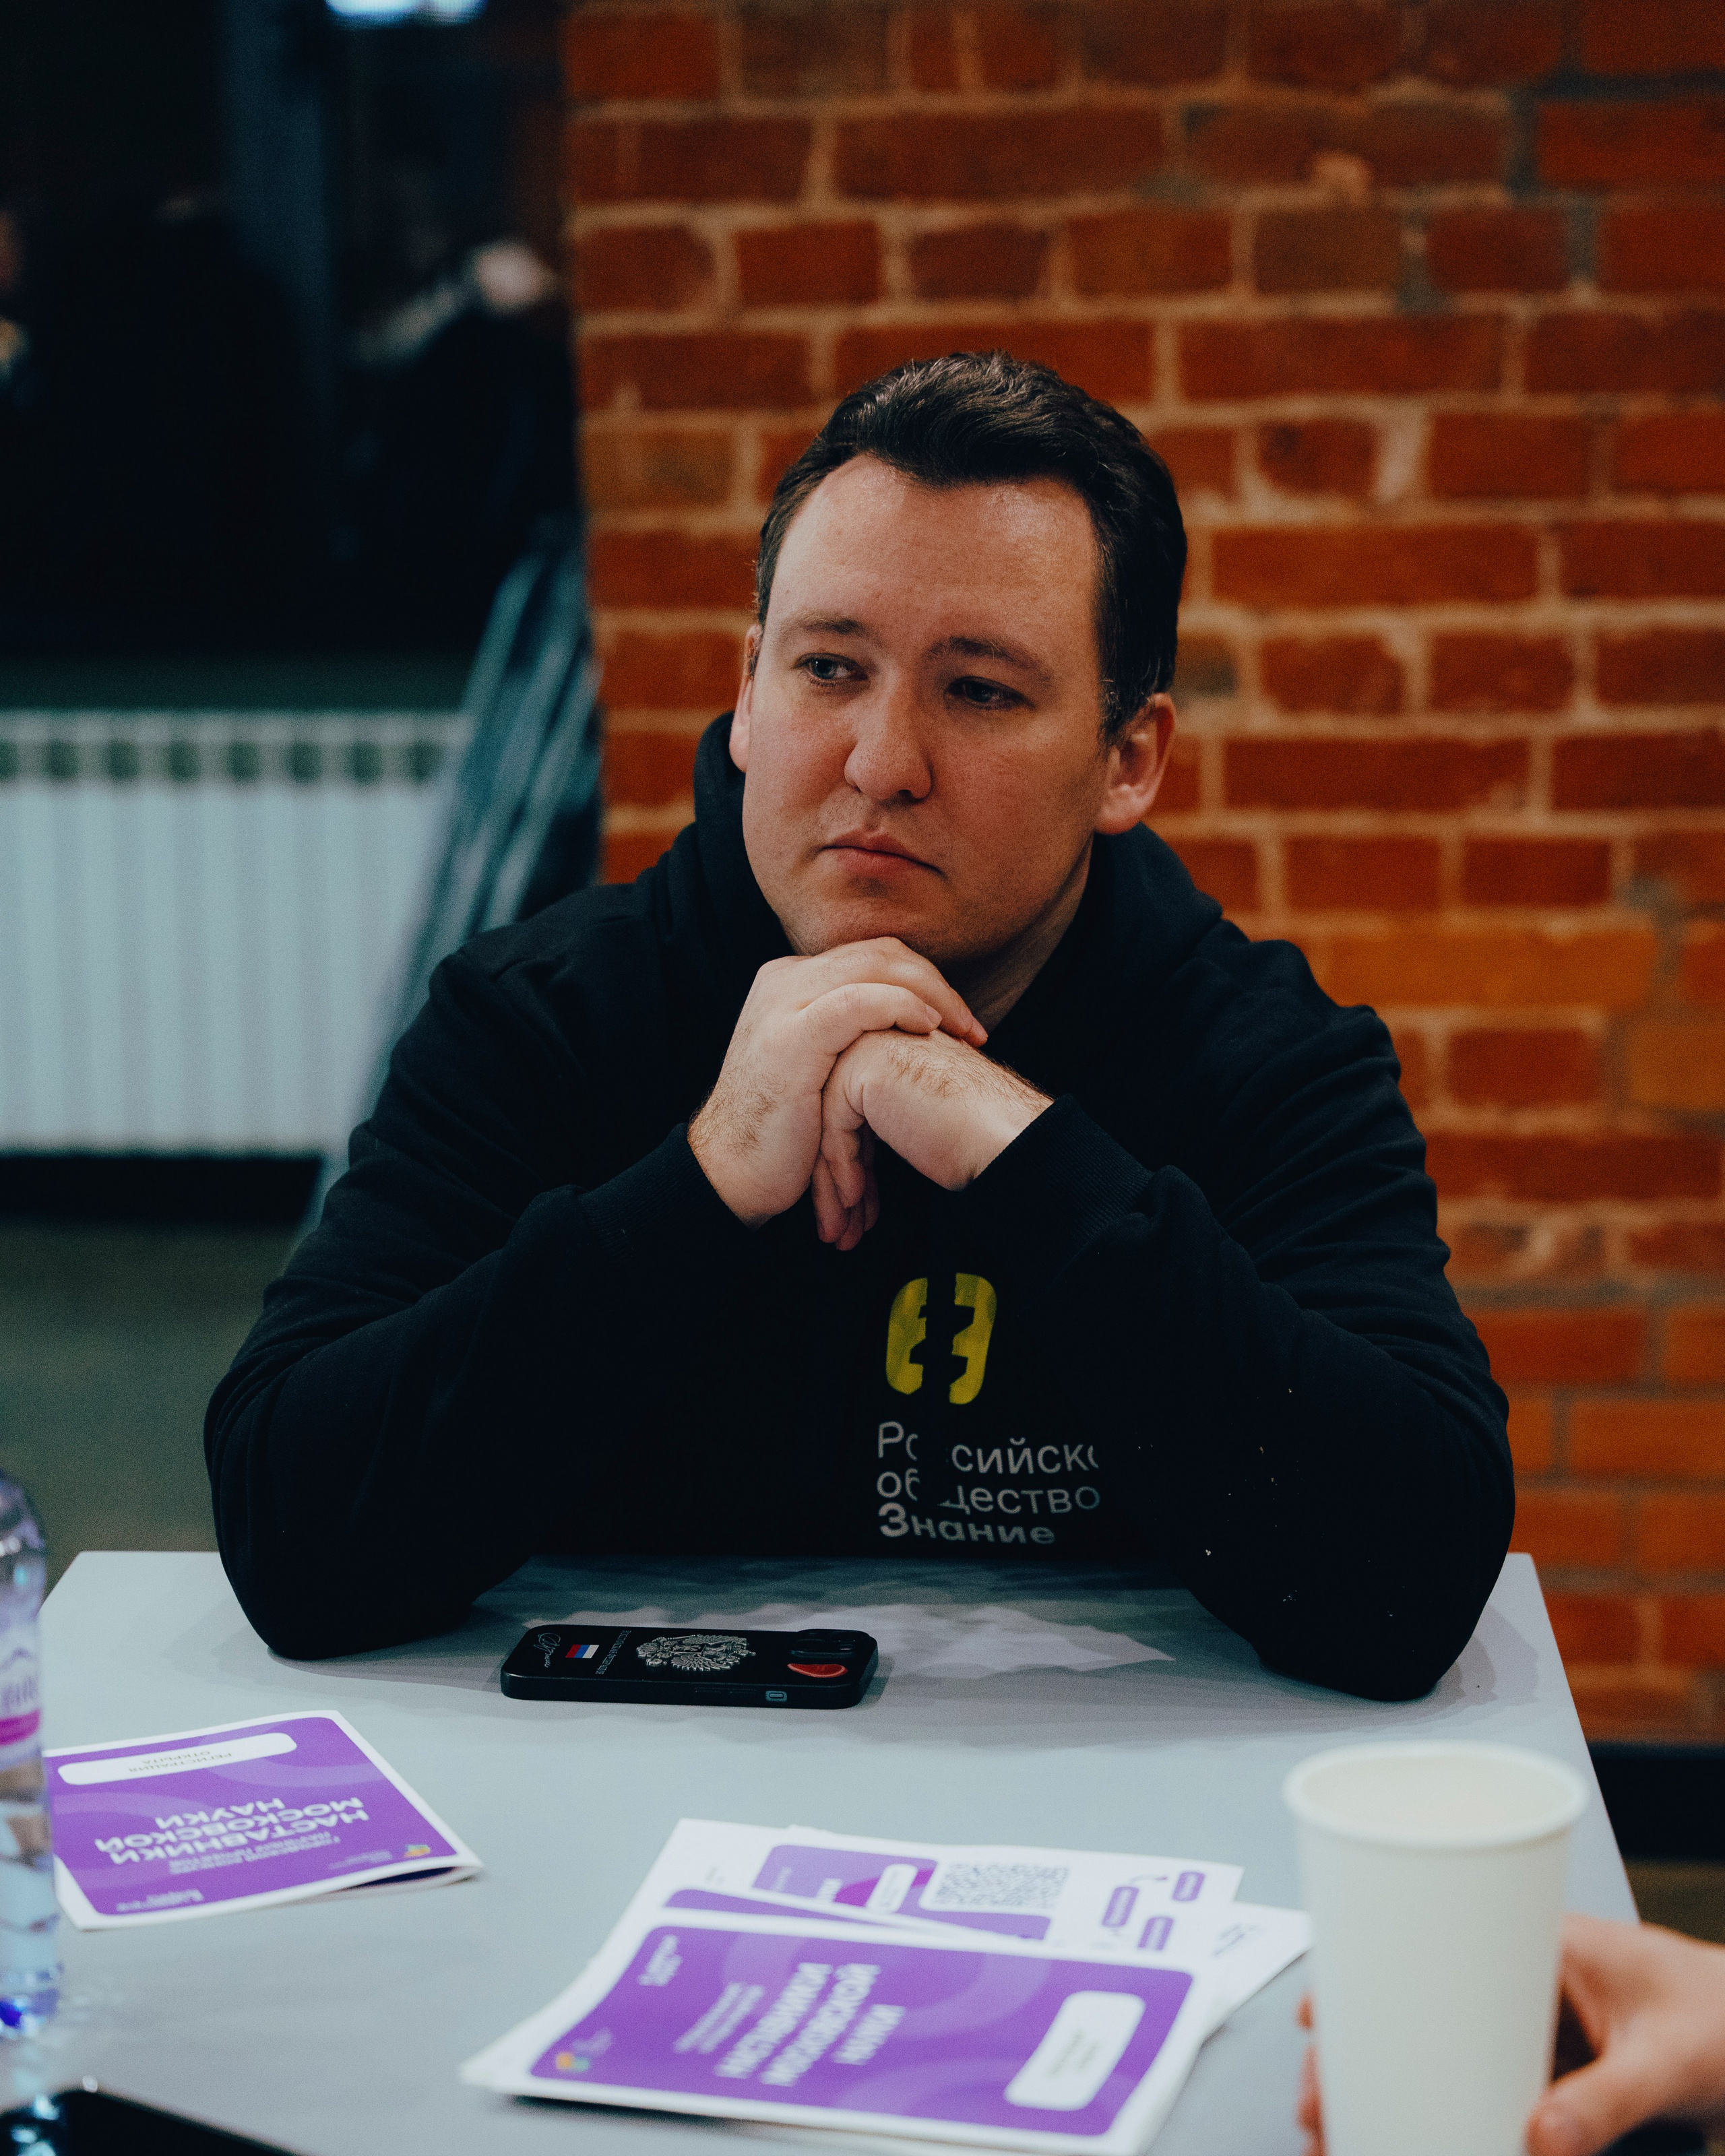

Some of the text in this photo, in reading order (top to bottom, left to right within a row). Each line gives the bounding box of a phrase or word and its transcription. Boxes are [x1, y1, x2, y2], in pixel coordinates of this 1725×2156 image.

[878, 1502, 1056, 1544] Знание
[128, 1752, 232, 1773] РЕГИСТРАЦИЯ
[142, 1751, 210, 1765] ОТКРЫТА
[94, 1796, 364, 1853] МОСКОВСКОЙ
[154, 1797, 286, 1830] НАУКИ
[109, 1809, 369, 1866] НАСТАВНИКИ
